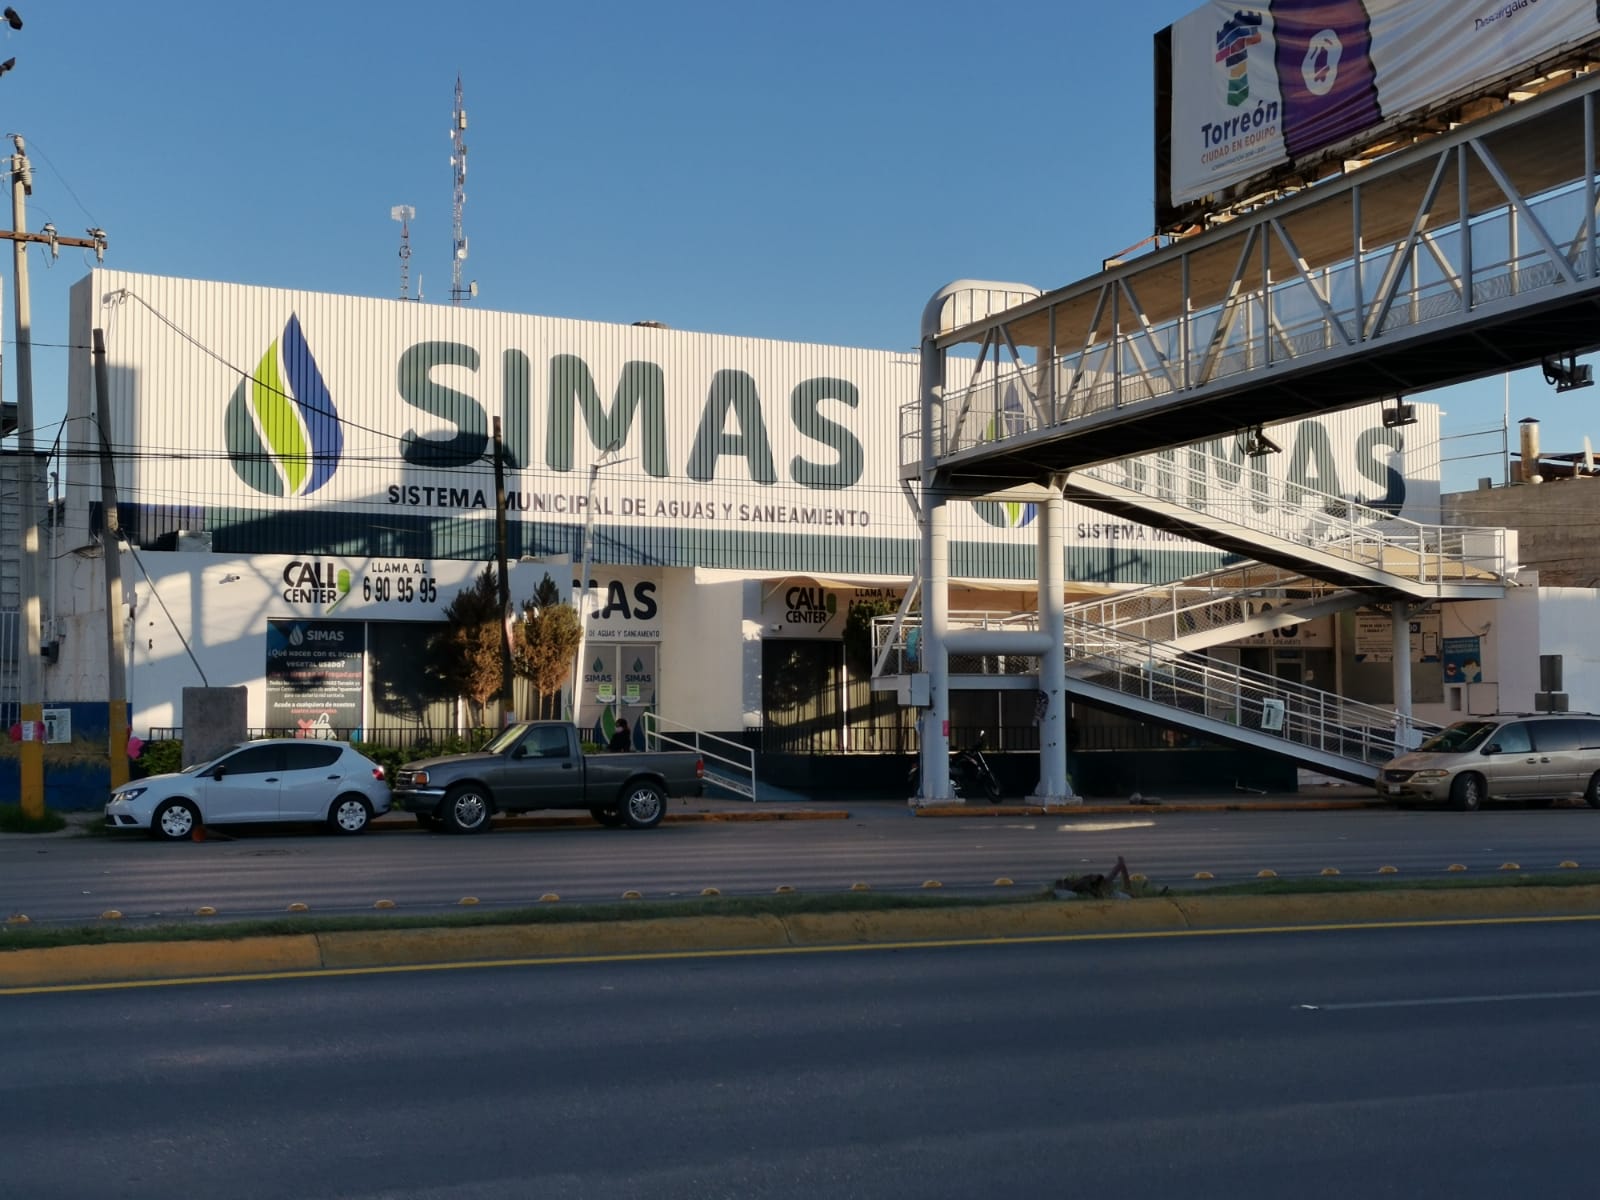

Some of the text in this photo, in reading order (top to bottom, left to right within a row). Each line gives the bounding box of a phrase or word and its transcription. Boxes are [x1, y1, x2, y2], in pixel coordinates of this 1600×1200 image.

[1201, 99, 1279, 149] Torreón
[1201, 145, 1230, 164] CIUDAD
[1232, 138, 1243, 153] EN
[1245, 126, 1276, 146] EQUIPO
[397, 340, 865, 490] SIMAS
[388, 485, 870, 527] SISTEMA MUNICIPAL DE AGUAS Y SANEAMIENTO
[1077, 523, 1145, 541] SISTEMA
[283, 561, 336, 588] CALL
[371, 562, 428, 574] LLAMA AL
[283, 588, 337, 604] CENTER
[363, 576, 437, 603] 6 90 95 95
[785, 586, 826, 611] CALL
[855, 587, 897, 599] LLAMA AL
[785, 610, 827, 624] CENTER
[306, 630, 345, 641] SIMAS
[584, 674, 612, 683] SIMAS
[625, 674, 652, 683] SIMAS
